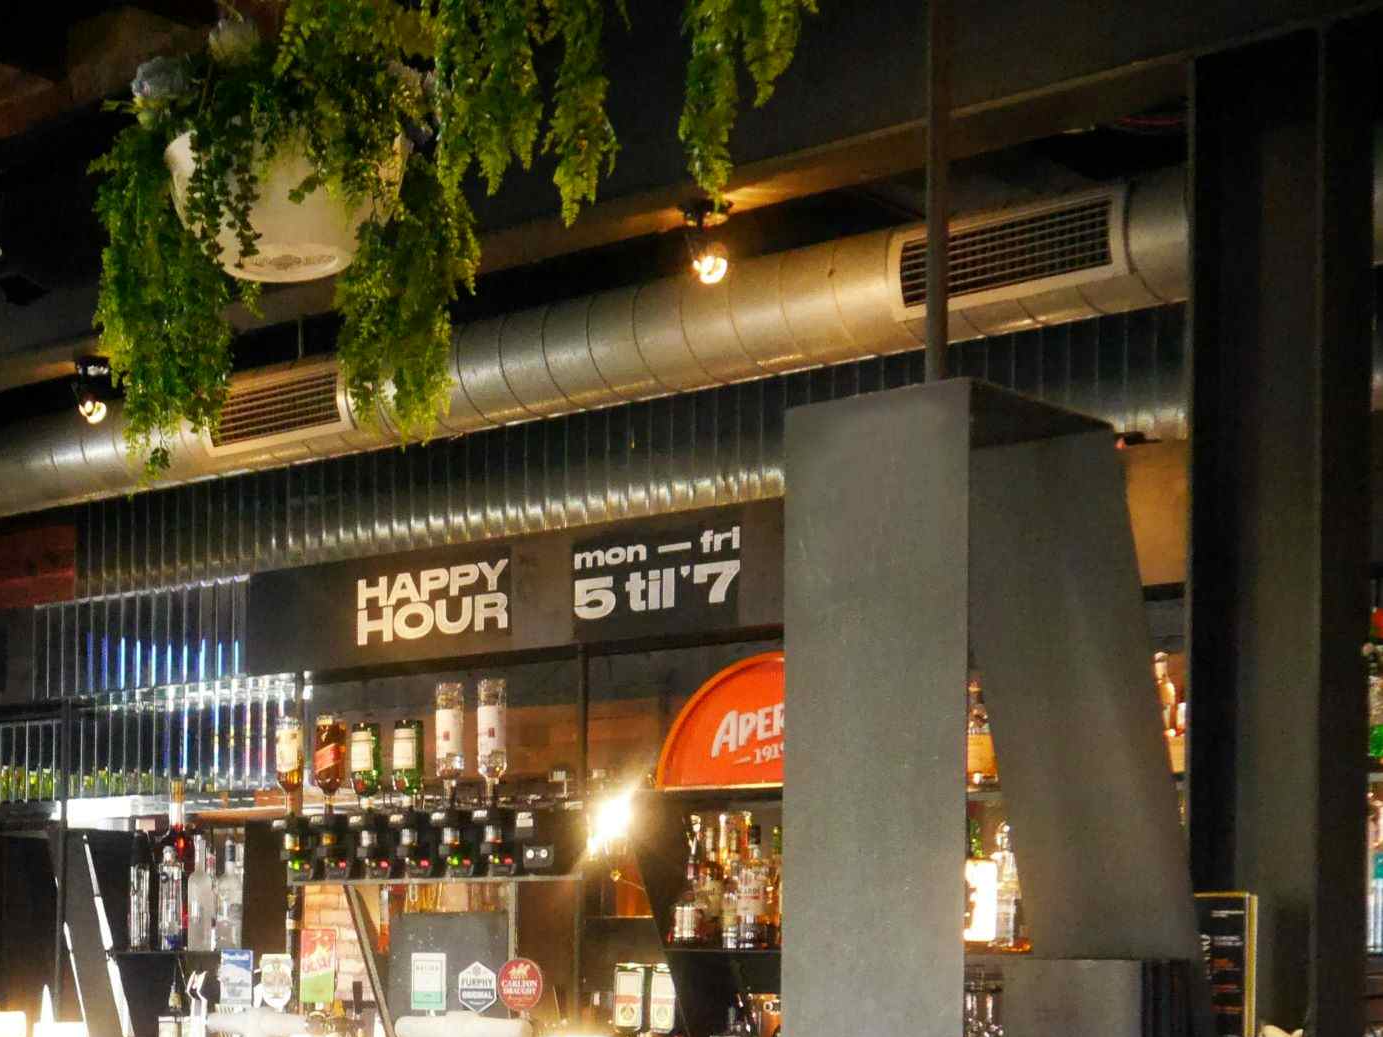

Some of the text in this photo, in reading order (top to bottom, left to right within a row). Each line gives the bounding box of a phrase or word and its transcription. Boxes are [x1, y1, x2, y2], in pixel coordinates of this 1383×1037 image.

[574, 543, 647, 570] mon
[700, 526, 741, 553] fri
[357, 558, 509, 610] HAPPY
[574, 576, 616, 620] 5
[357, 591, 508, 646] HOUR
